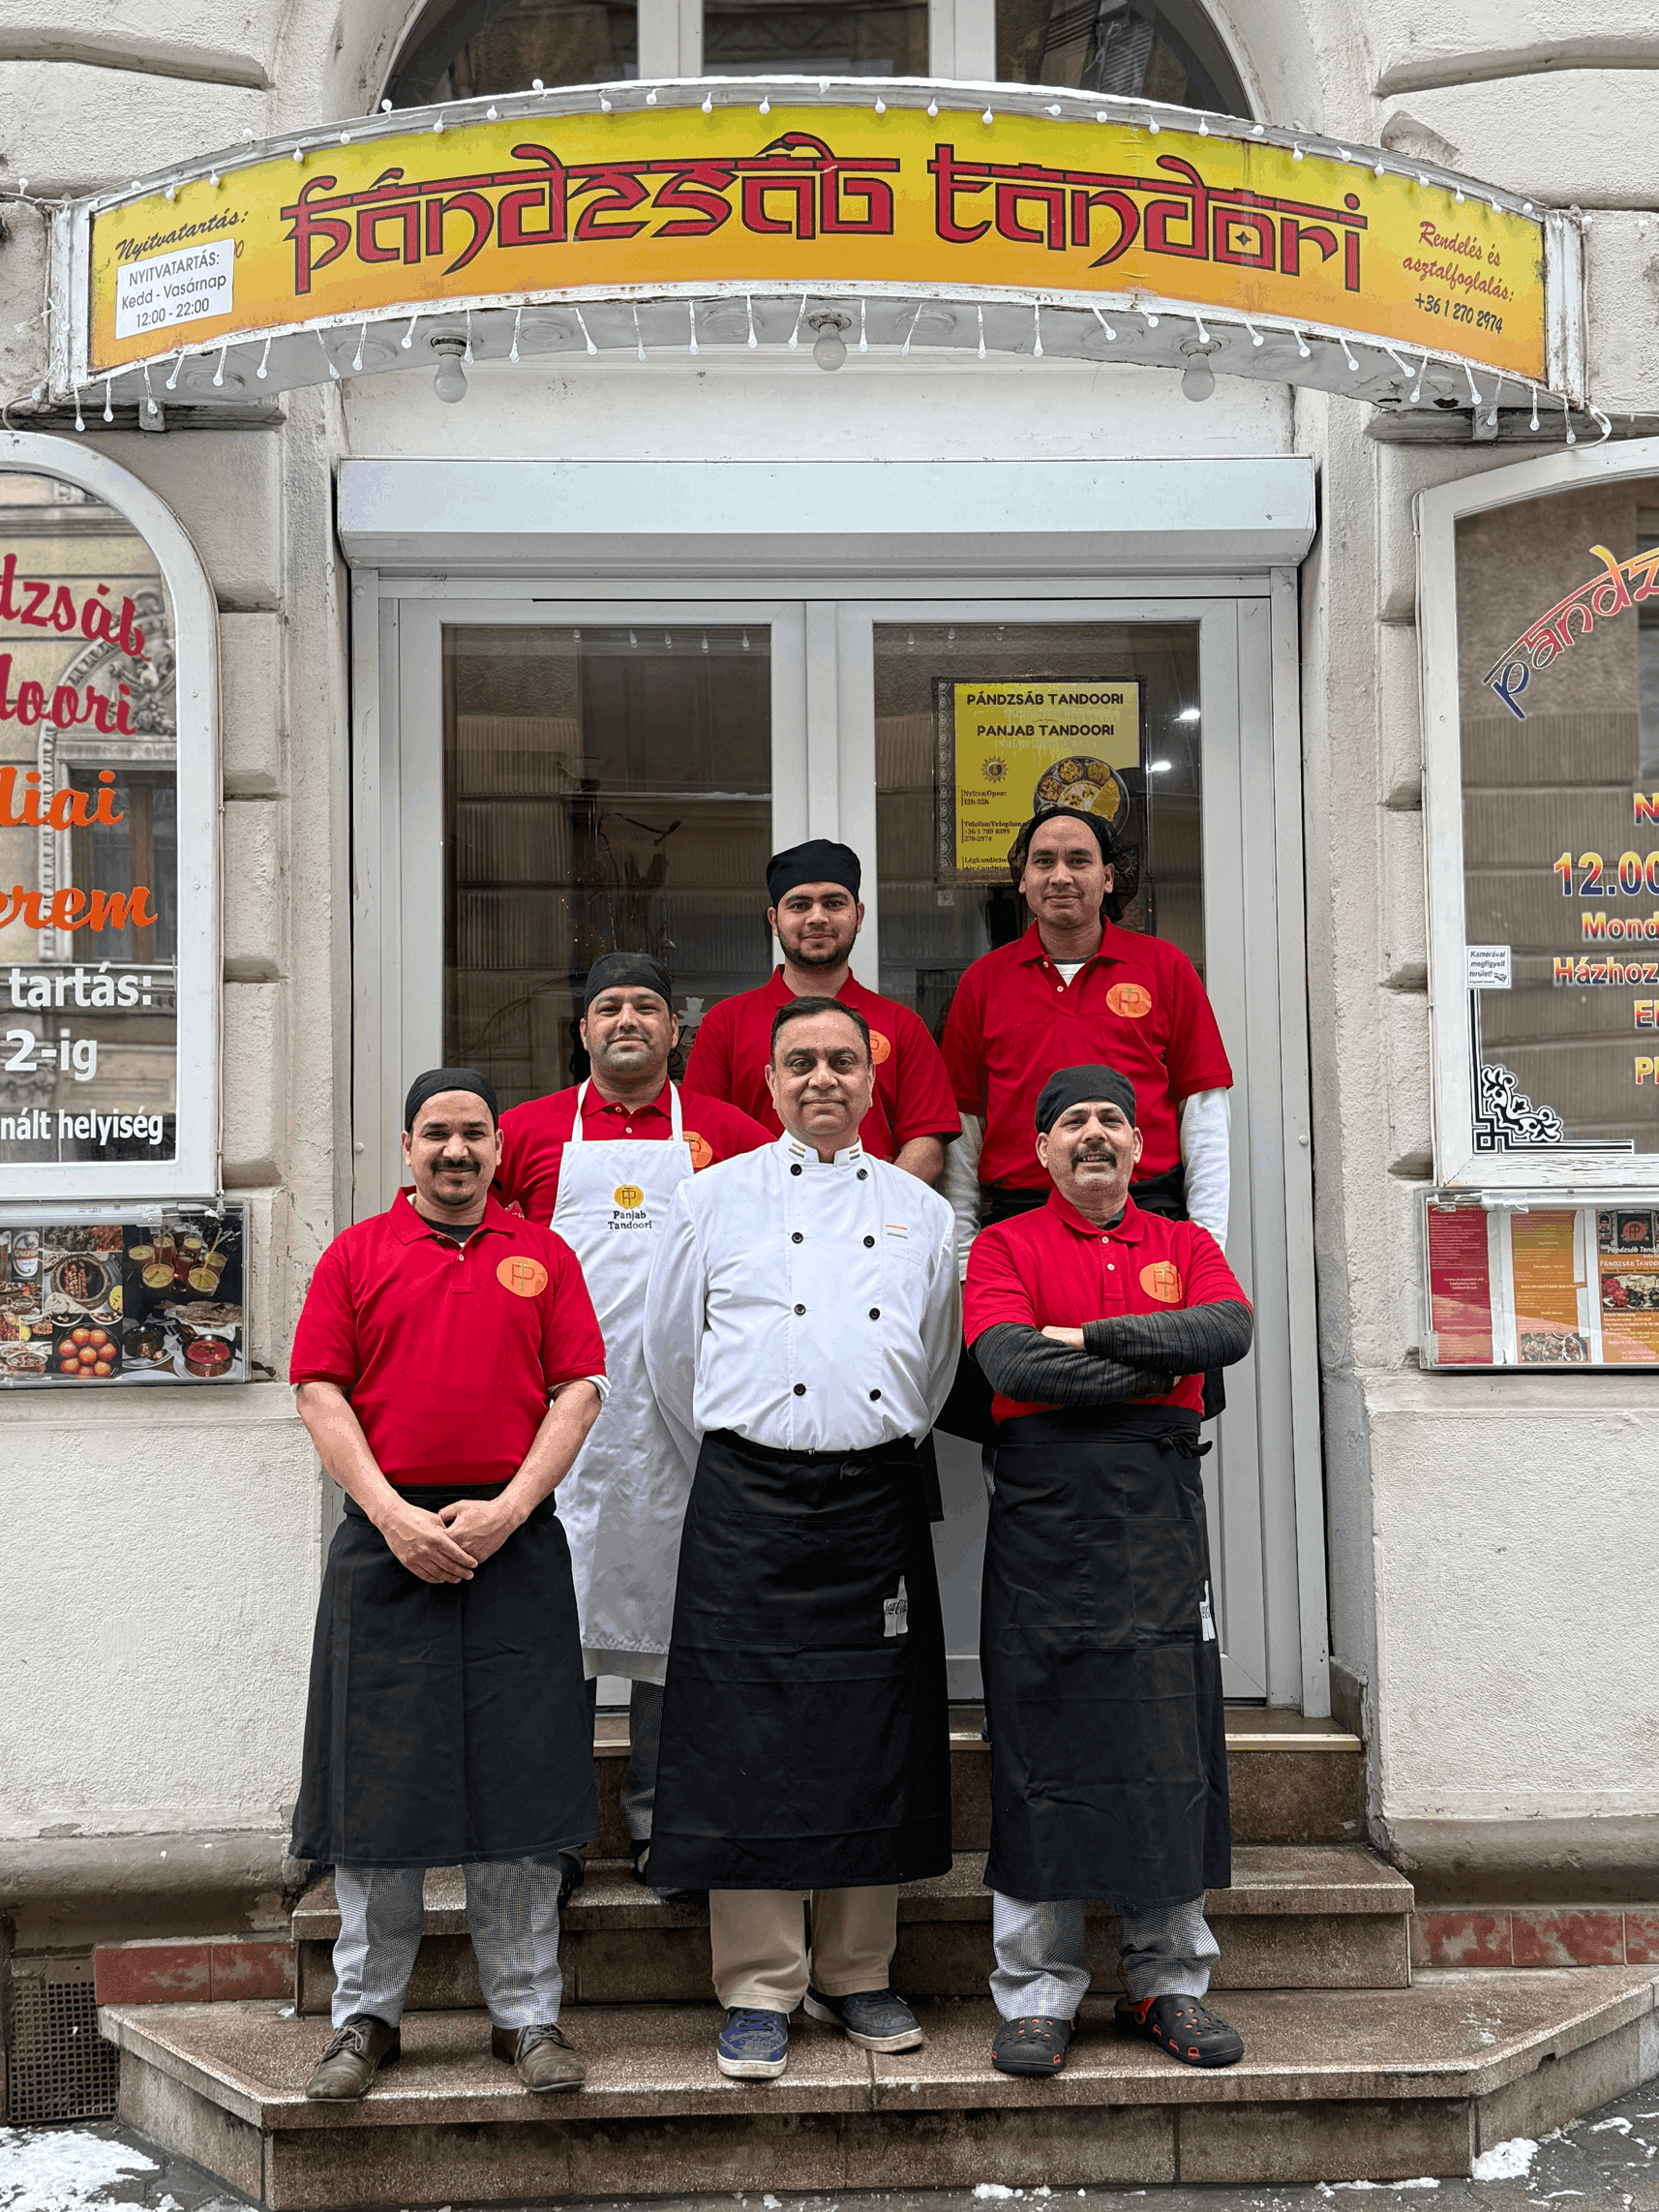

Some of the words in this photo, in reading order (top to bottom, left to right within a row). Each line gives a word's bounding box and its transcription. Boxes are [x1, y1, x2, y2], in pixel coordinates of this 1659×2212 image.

[114, 207, 249, 262] Nyitvatartás:
[1419, 221, 1484, 261] Rendelés
[1487, 243, 1501, 267] és
[129, 249, 220, 287] NYITVATARTÁS:
[1403, 256, 1516, 303] asztalfoglalás:
[122, 289, 153, 311] Kedd
[164, 275, 227, 299] Vasárnap
[136, 307, 166, 328] 12:00
[176, 298, 210, 318] 22:00
[1414, 292, 1440, 316] +36
[1453, 302, 1474, 325] 270
[1476, 311, 1503, 335] 2974
[966, 690, 1044, 706] PÁNDZSÁB
[1047, 692, 1125, 705] TANDOORI
[977, 724, 1036, 737] PANJAB
[1038, 724, 1115, 737] TANDOORI
[1469, 950, 1506, 958] Kamerával
[1470, 959, 1506, 969] megfigyelt
[8, 960, 152, 1008] tartás:
[4, 1028, 98, 1081] 2-ig
[58, 1105, 164, 1147] helyiség
[608, 1220, 652, 1230] Tandoori
[613, 1209, 647, 1222] Panjab
